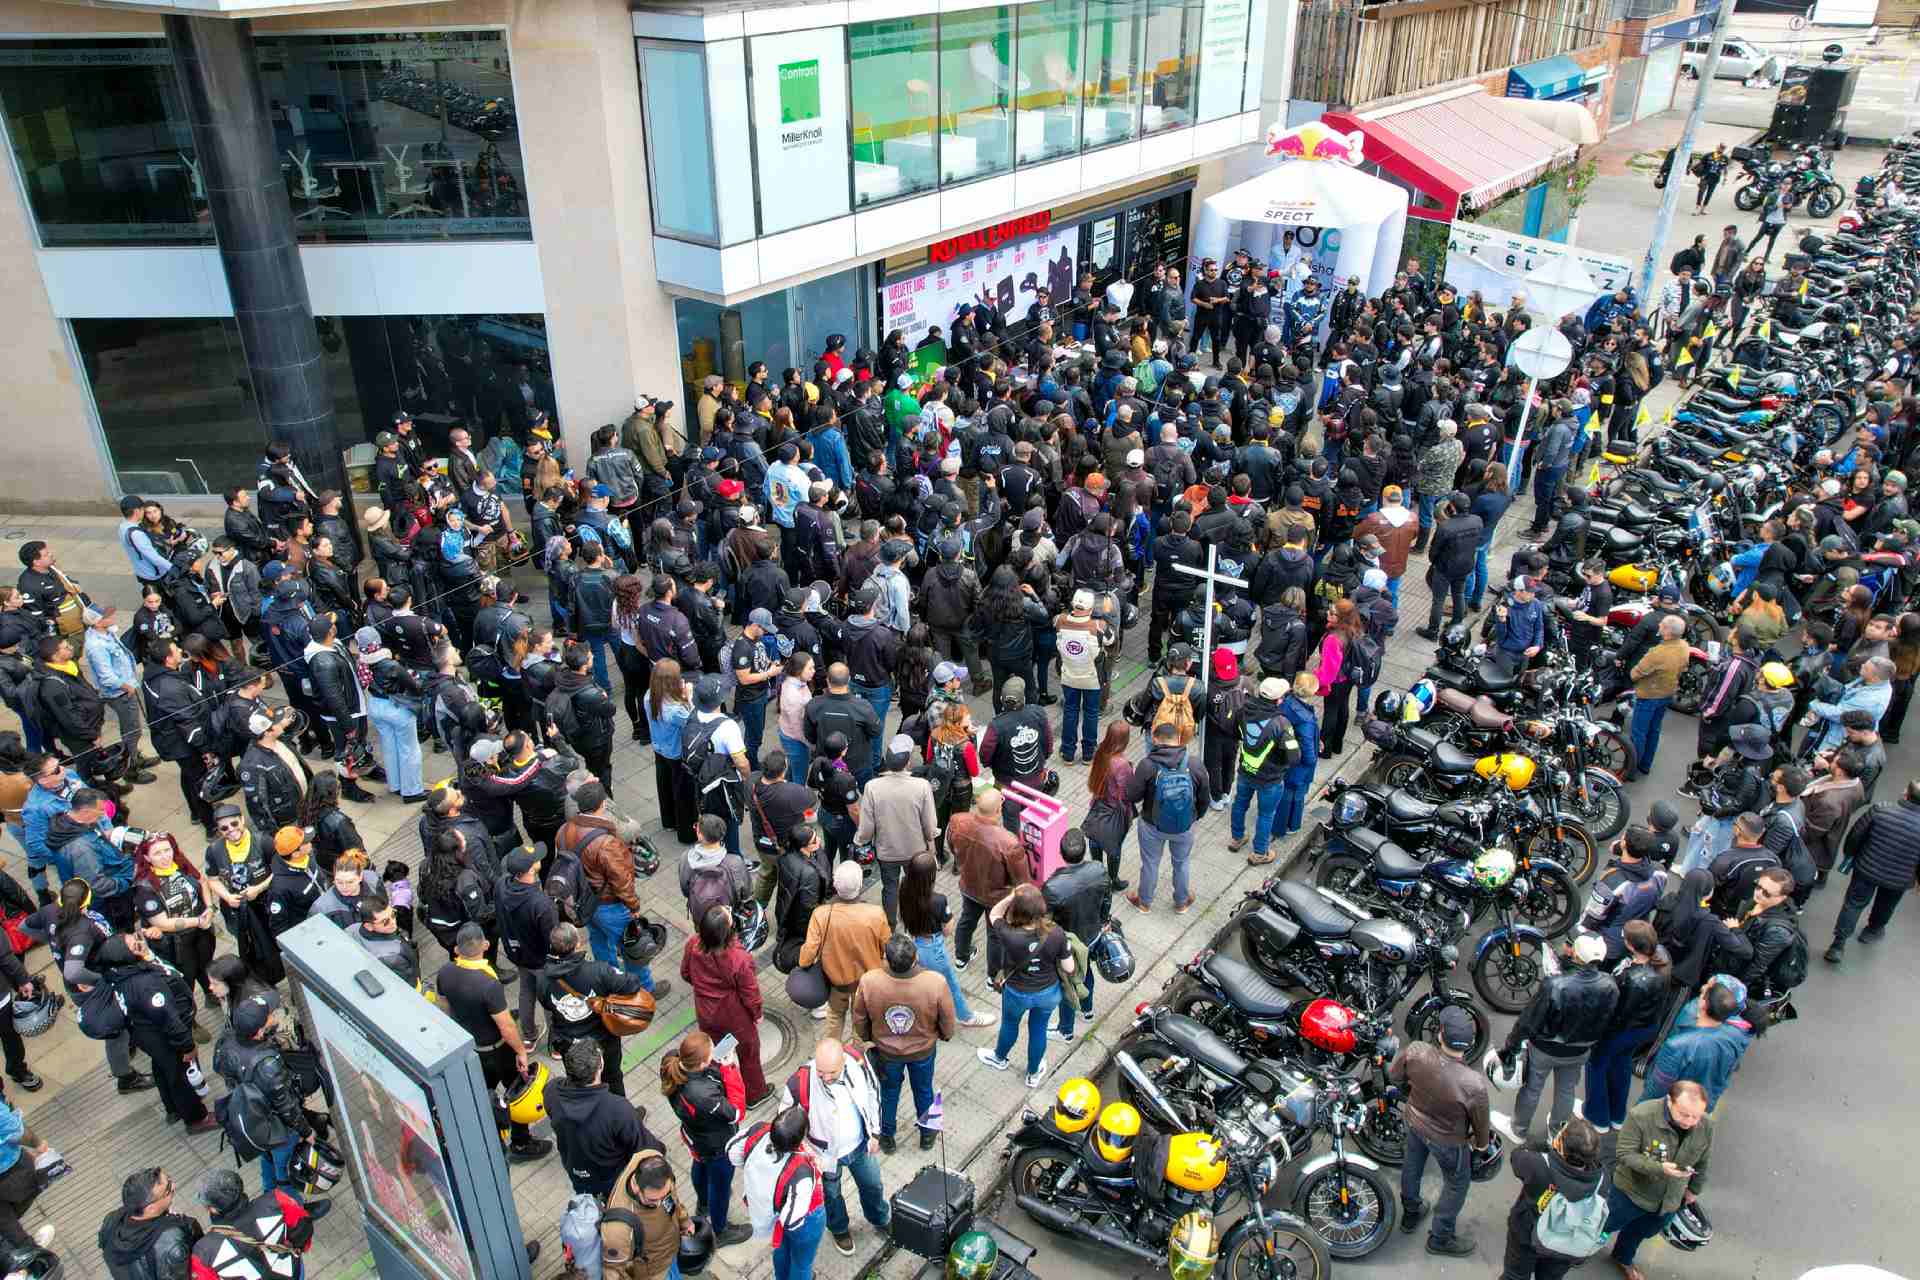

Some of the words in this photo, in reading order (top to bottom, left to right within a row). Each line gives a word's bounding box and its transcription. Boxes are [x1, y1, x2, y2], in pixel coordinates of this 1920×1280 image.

[779, 63, 818, 81] Contract
[781, 127, 823, 144] MillerKnoll
[1263, 210, 1315, 222] SPECT
[1448, 240, 1458, 252] A
